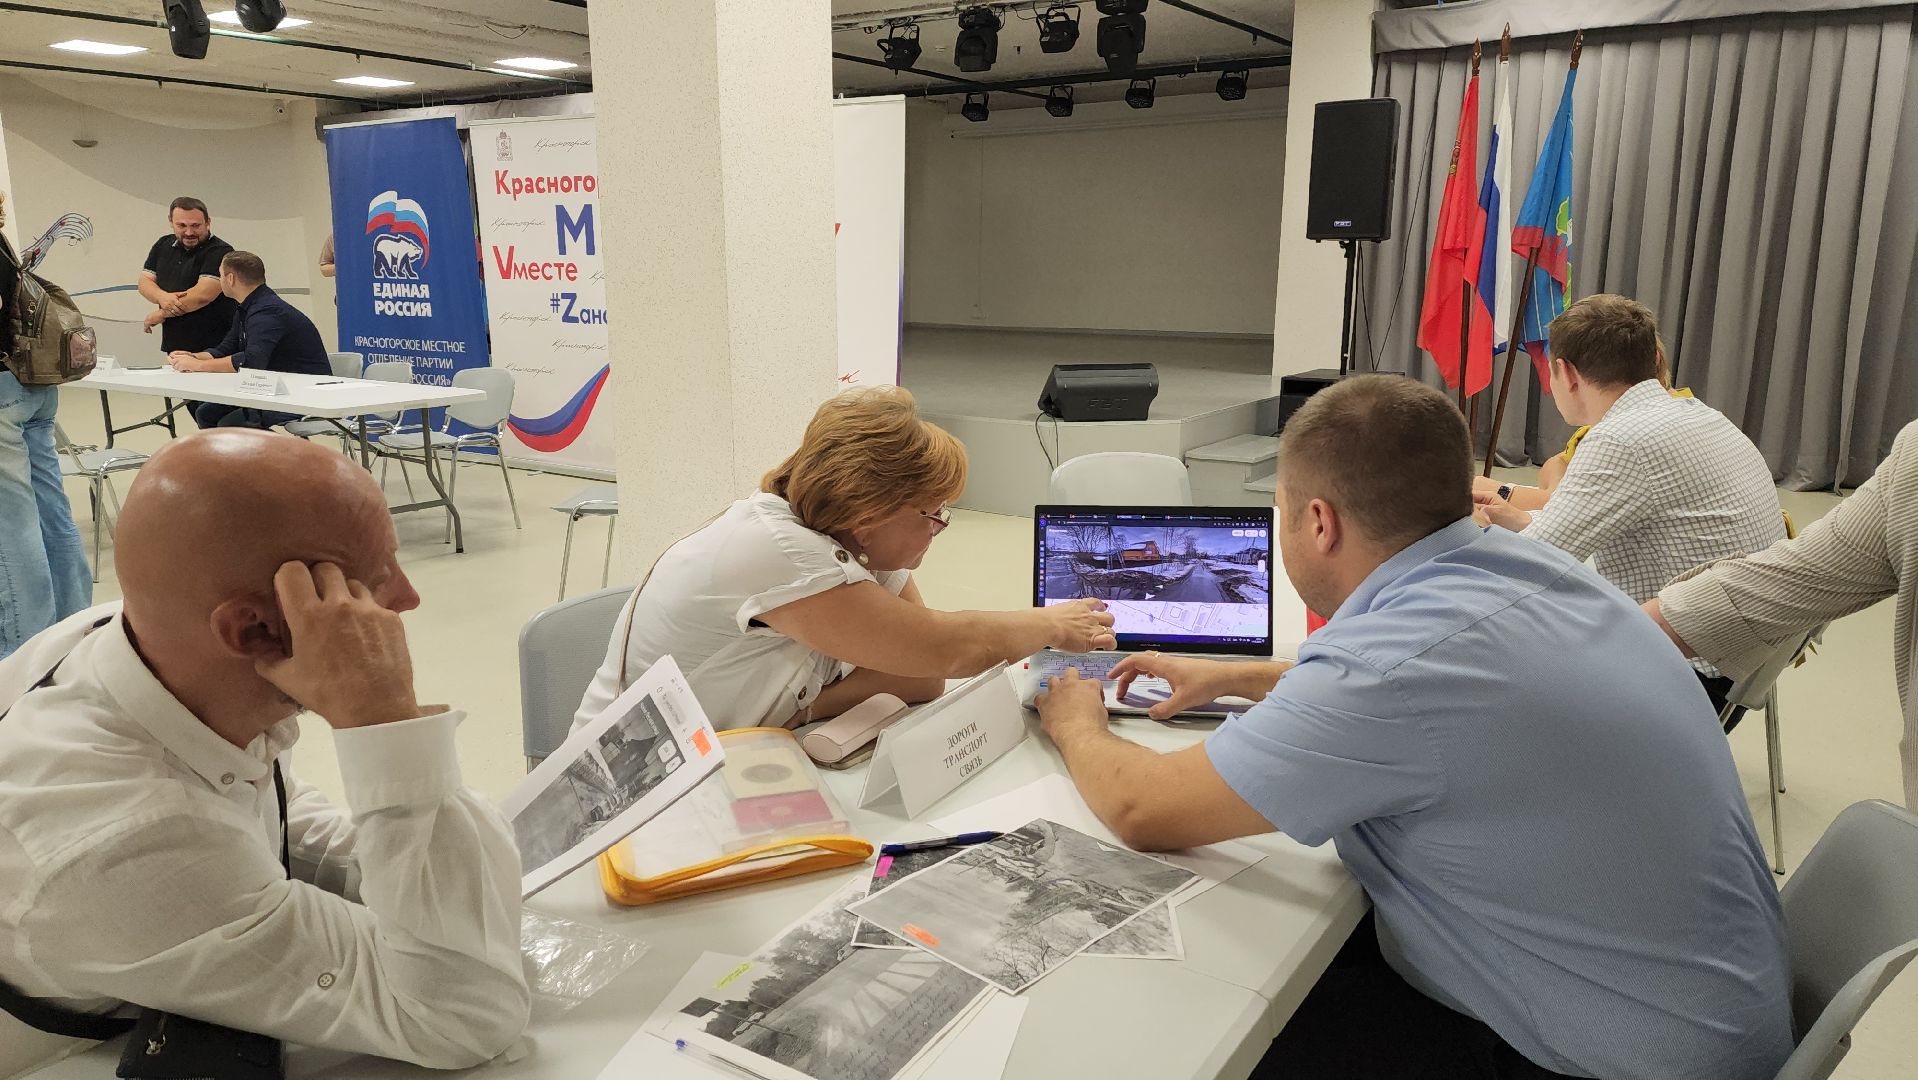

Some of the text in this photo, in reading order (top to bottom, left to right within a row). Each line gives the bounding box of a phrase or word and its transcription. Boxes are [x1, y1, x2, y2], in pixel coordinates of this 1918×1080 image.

[494, 169, 600, 201] Красного
[492, 245, 578, 281] Vместе
[372, 282, 430, 299] ЕДИНАЯ
[374, 300, 433, 317] РОССИЯ
[354, 335, 466, 353] КРАСНОГОРСКОЕ МЕСТНОЕ
[416, 356, 454, 369] ПАРТИИ
[946, 720, 978, 750] ДОРОГИ
[943, 731, 988, 769] ТРАНСПОРТ
[959, 755, 983, 778] СВЯЗЬ
